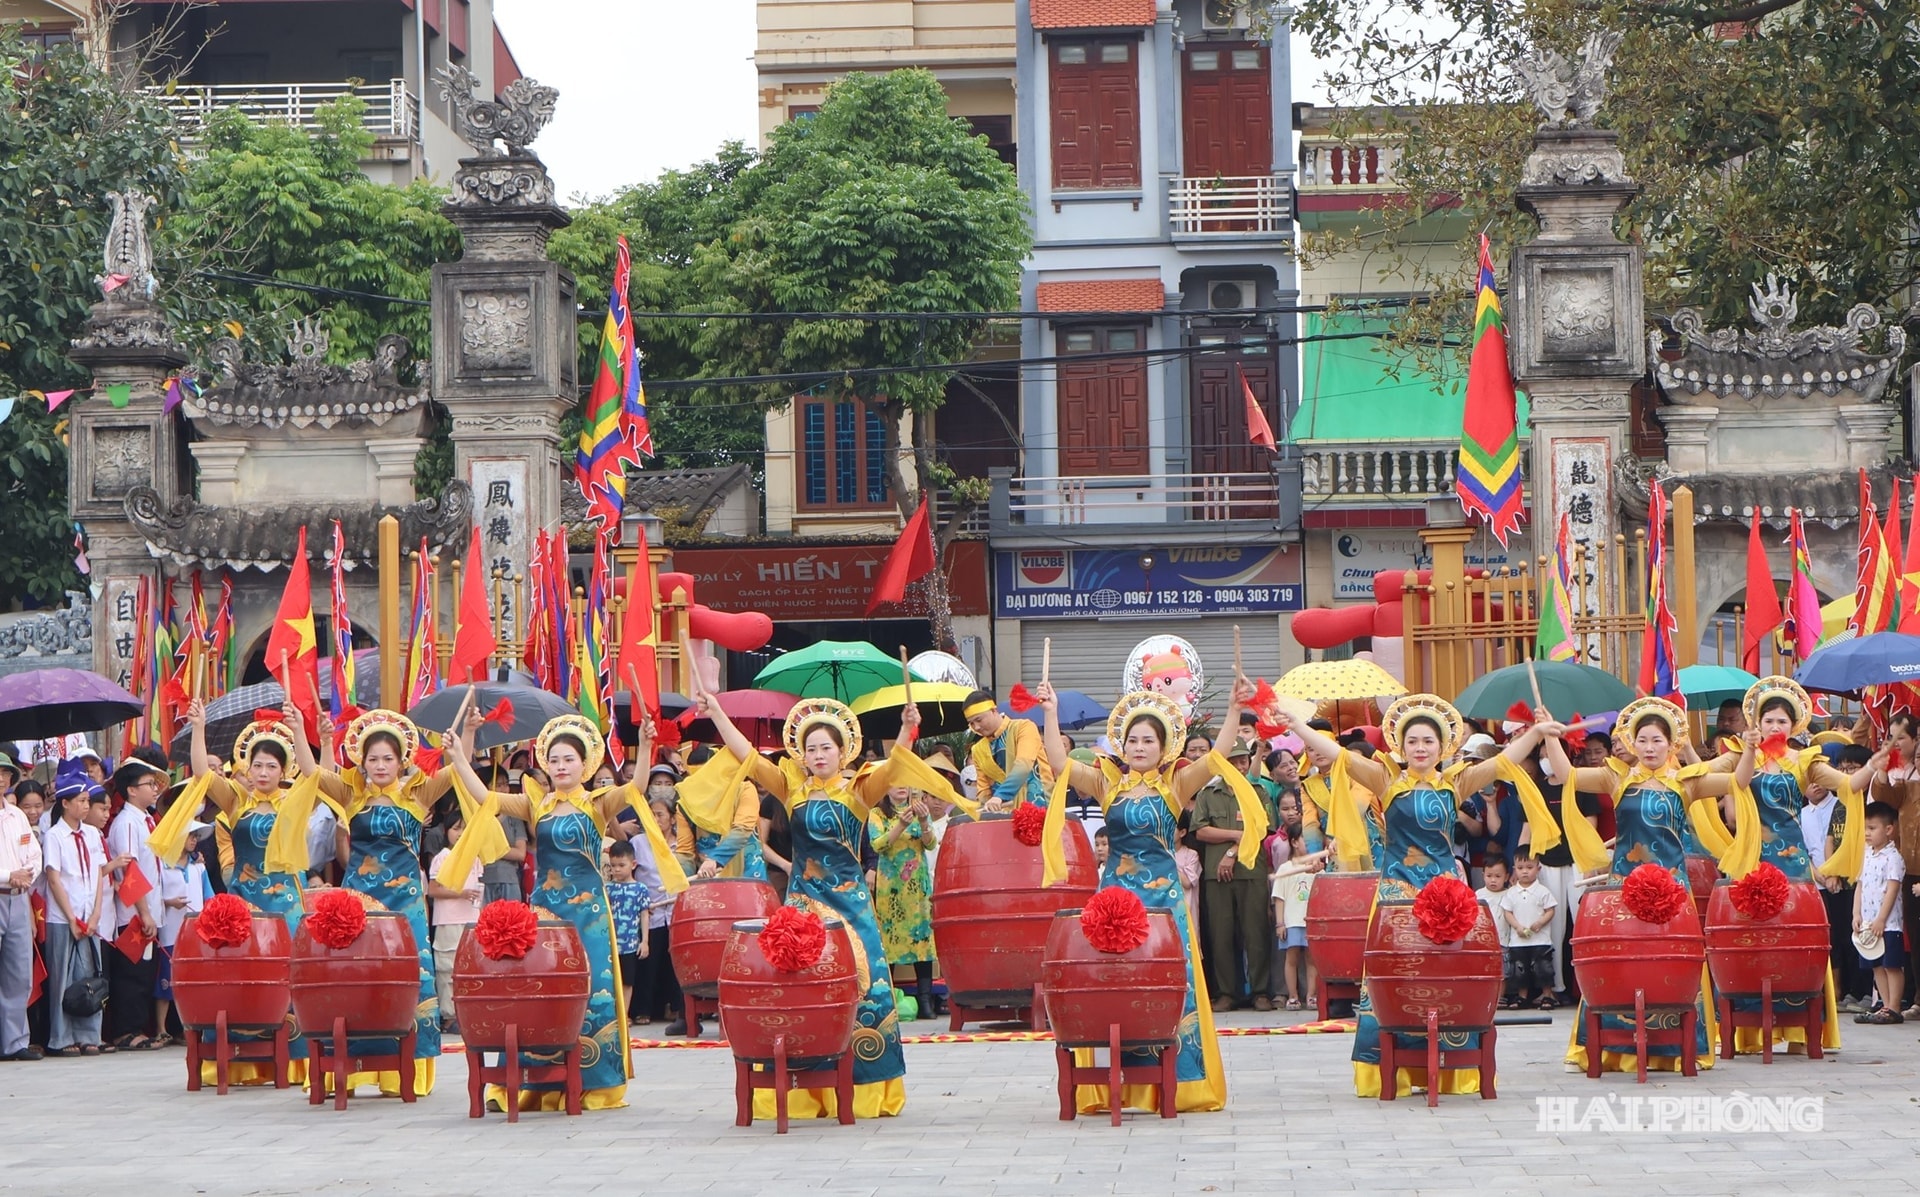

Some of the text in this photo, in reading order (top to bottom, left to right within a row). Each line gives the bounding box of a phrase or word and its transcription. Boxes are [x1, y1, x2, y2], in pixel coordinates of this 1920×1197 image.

[1168, 547, 1242, 563] Vilube
[724, 571, 743, 581] LÝ
[758, 555, 841, 581] HIẾN
[1006, 594, 1026, 611] ĐẠI
[1030, 592, 1072, 607] DƯƠNG
[1075, 593, 1090, 607] AT
[1124, 591, 1153, 605] 0967
[1156, 590, 1179, 604] 152
[1182, 590, 1203, 604] 126
[1214, 589, 1244, 603] 0904
[1247, 588, 1269, 602] 303
[1272, 588, 1293, 602] 719
